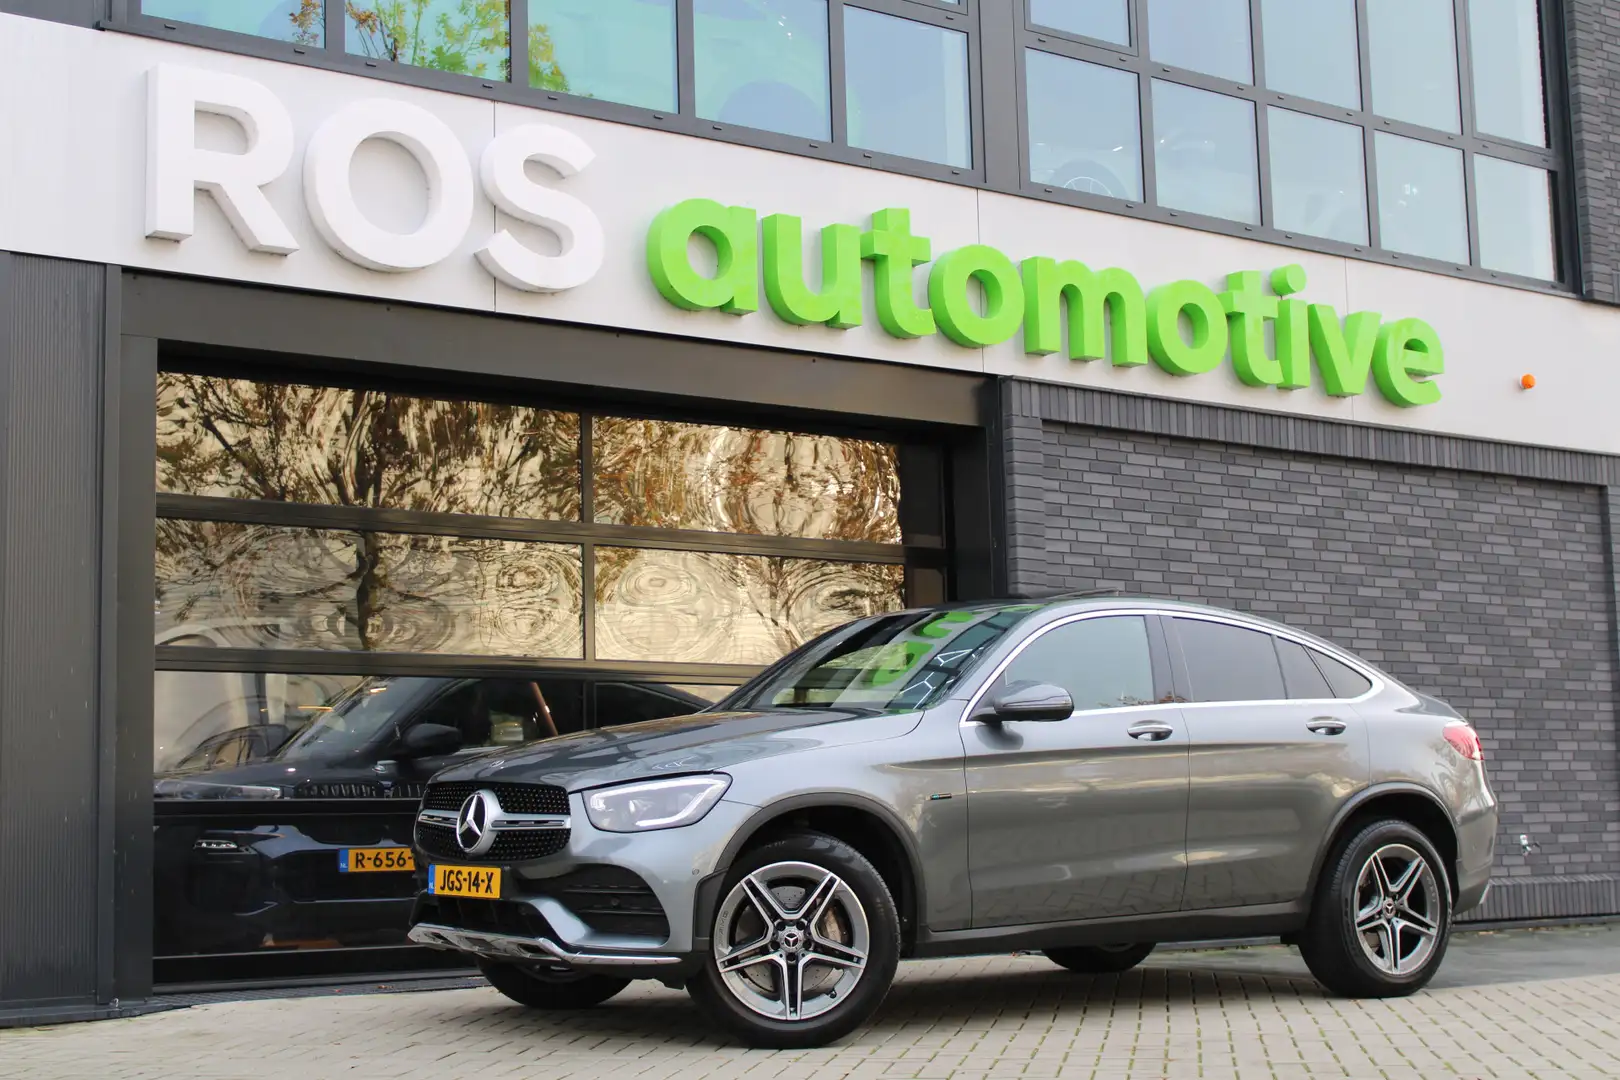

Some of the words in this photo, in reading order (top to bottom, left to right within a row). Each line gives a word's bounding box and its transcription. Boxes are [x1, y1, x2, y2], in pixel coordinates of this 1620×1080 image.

[144, 62, 605, 294] ROS
[646, 198, 1444, 408] automotive
[440, 869, 495, 894] JGS-14-X
